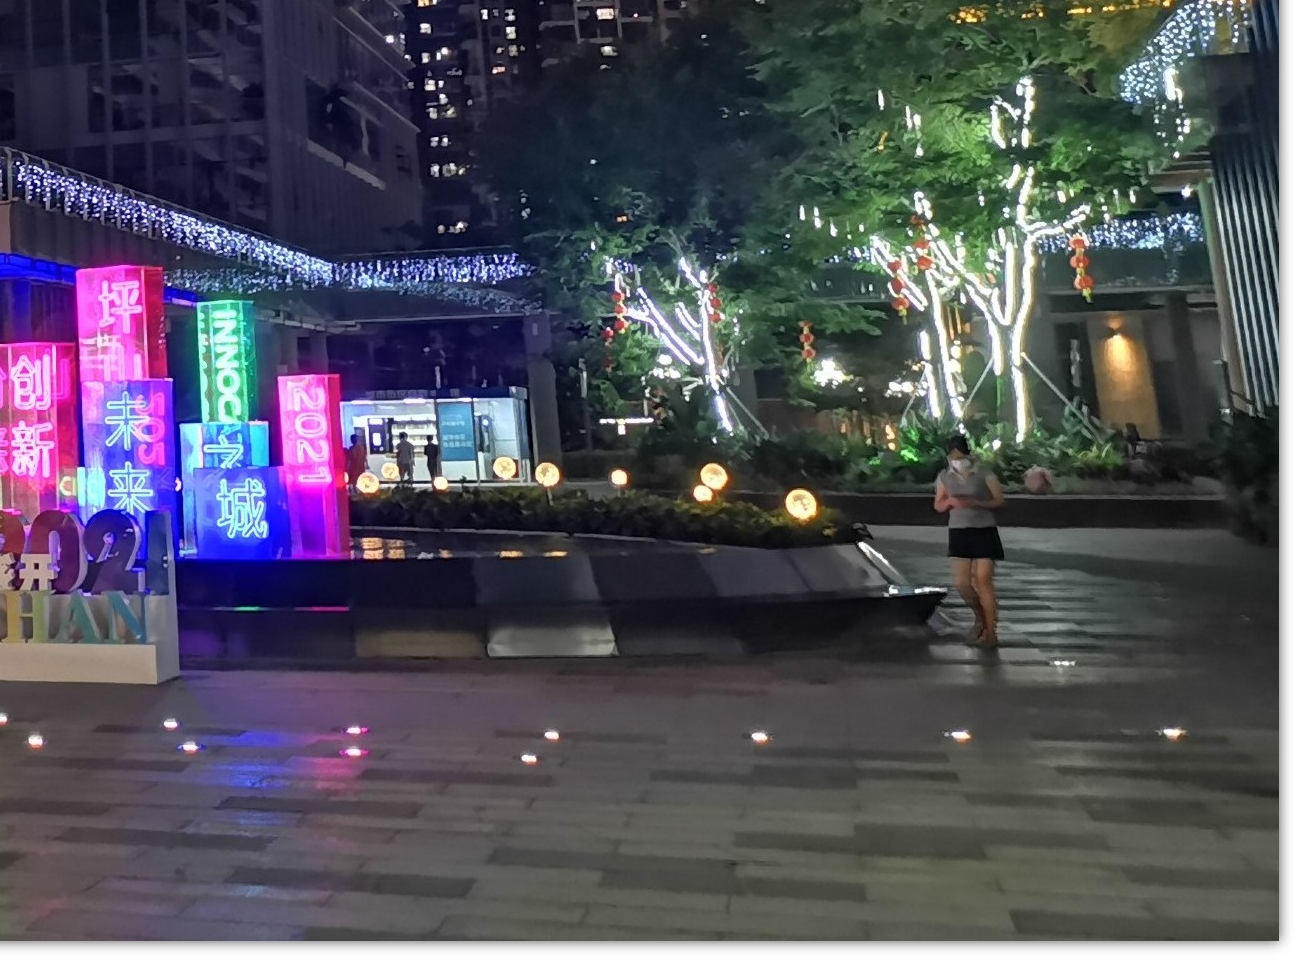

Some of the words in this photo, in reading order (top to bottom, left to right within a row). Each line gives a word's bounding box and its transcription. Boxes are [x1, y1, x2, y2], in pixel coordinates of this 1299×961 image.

[10, 353, 55, 478] 创新
[105, 390, 154, 515] 未来
[292, 386, 333, 484] 2021
[216, 477, 270, 539] 城
